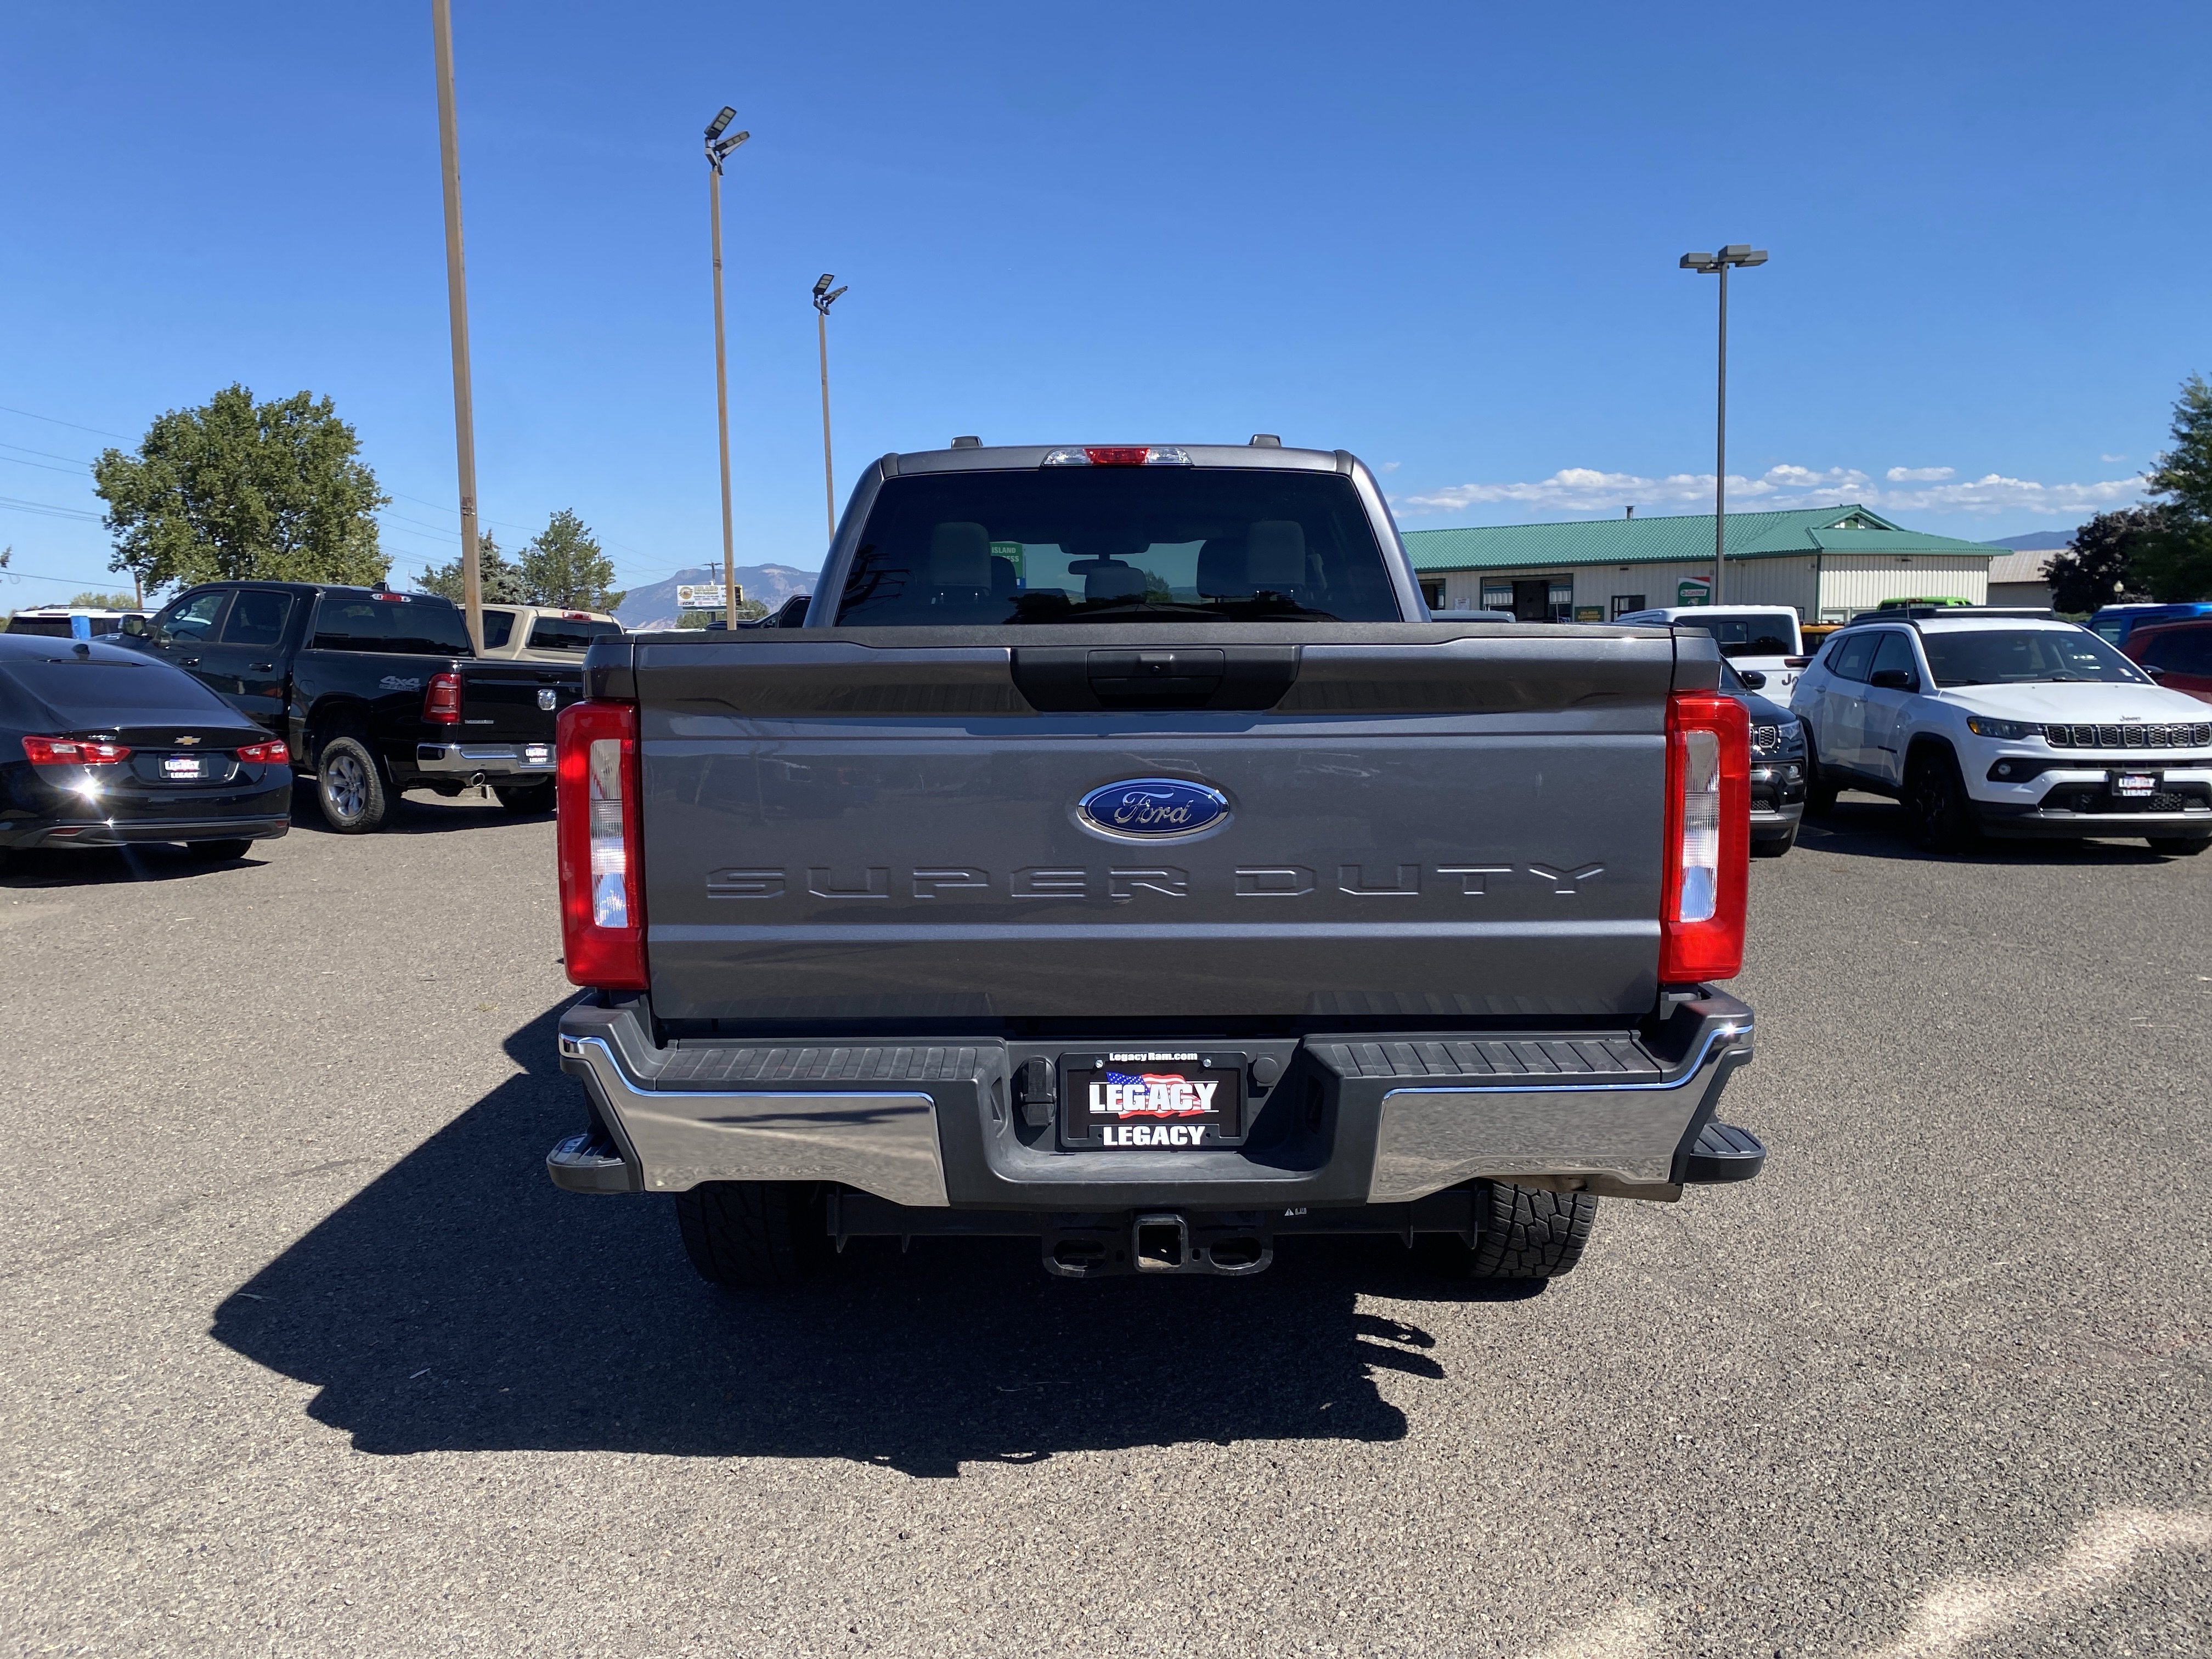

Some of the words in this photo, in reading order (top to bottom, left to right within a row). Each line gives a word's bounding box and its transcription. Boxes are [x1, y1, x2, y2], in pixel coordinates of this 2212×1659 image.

[165, 760, 200, 770] LEGACY
[2118, 777, 2155, 788] LEGACY
[1114, 791, 1194, 823] Ford
[706, 865, 1190, 899] SUPER
[1234, 862, 1605, 898] DUTY
[1089, 1083, 1218, 1111] LEGACY
[1103, 1125, 1206, 1146] LEGACY
